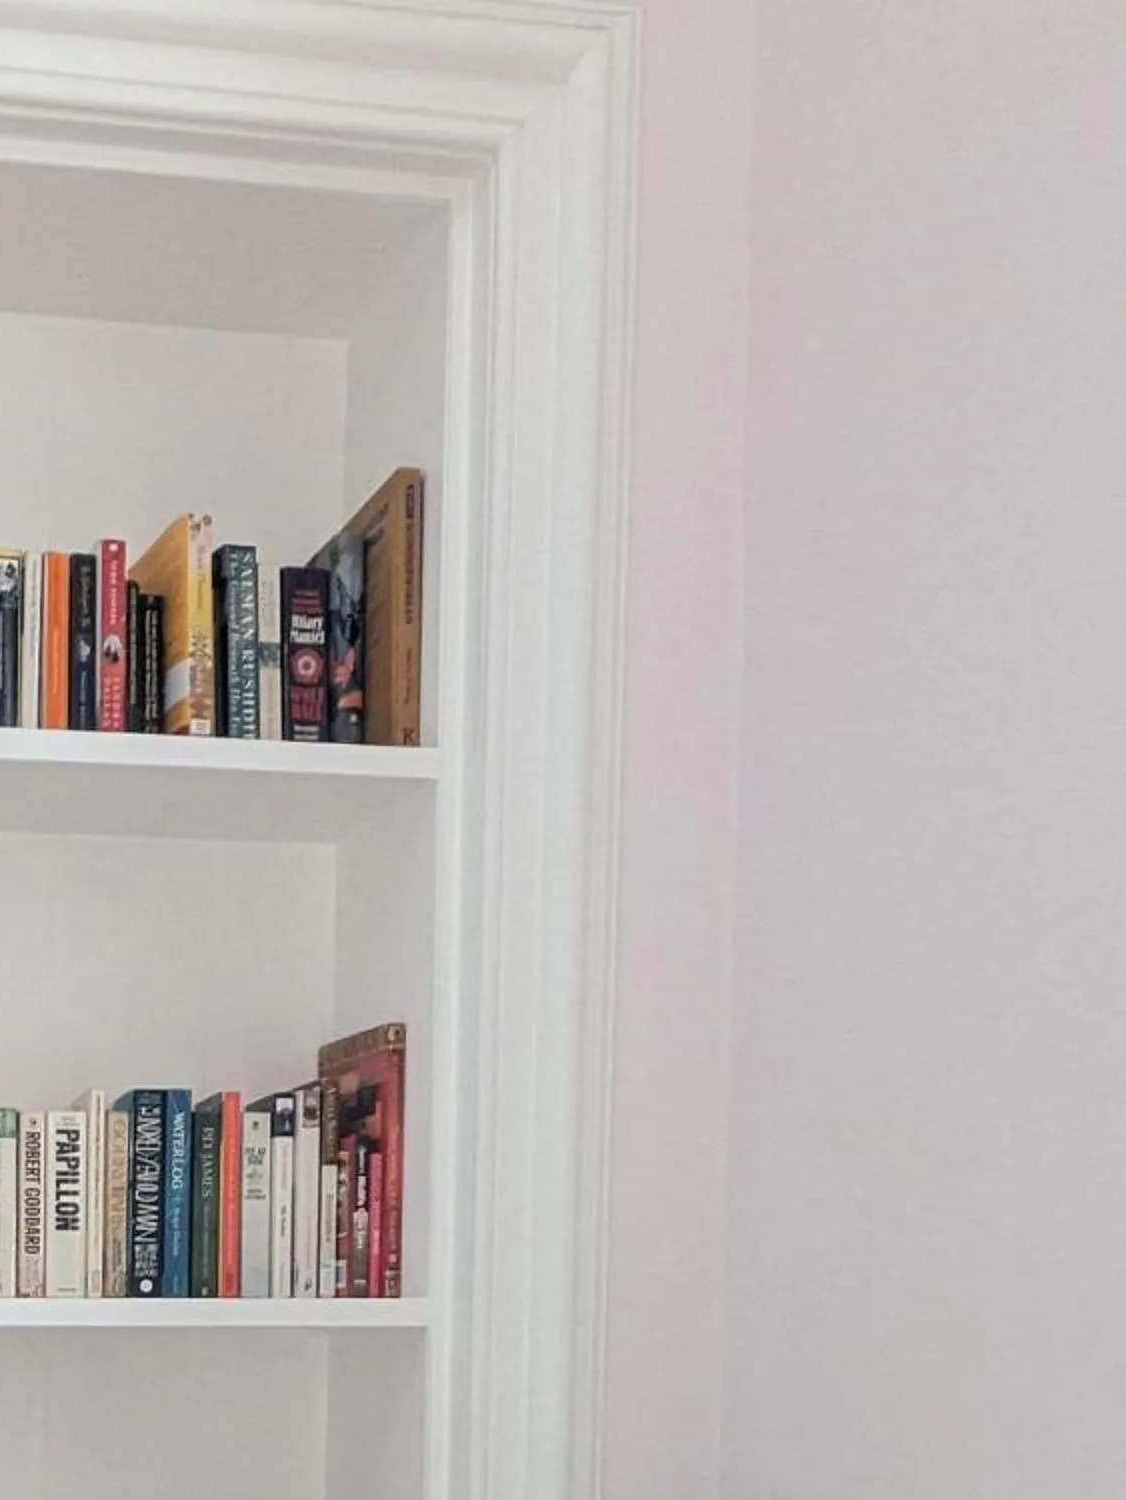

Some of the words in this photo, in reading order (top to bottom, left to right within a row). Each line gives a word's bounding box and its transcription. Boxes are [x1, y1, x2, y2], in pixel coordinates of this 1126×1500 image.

[240, 551, 257, 641] SALMAN
[24, 1131, 41, 1185] ROBERT
[55, 1129, 81, 1232] PAPILLON
[171, 1112, 185, 1189] WATERLOG
[24, 1187, 41, 1255] GODDARD
